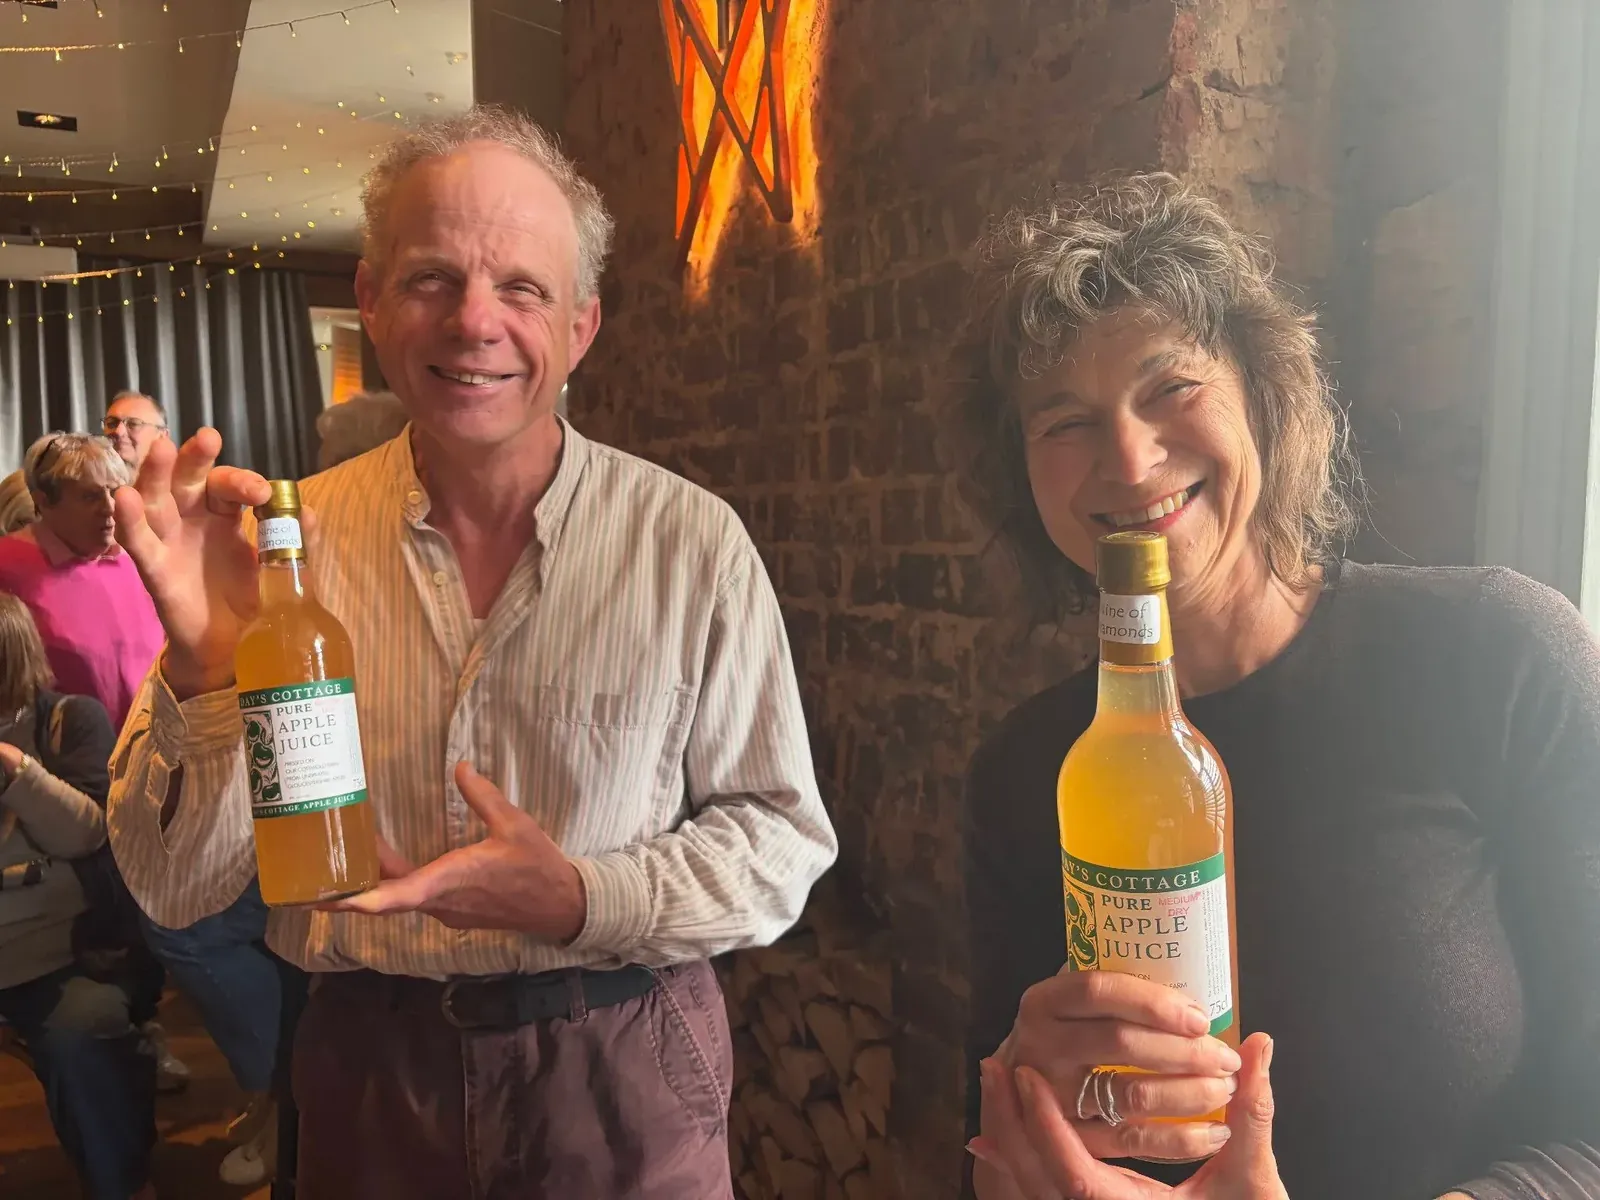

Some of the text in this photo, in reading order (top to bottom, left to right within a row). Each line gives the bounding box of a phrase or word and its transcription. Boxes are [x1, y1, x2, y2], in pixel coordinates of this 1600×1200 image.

[1103, 600, 1149, 618] ine of
[240, 683, 342, 707] DAY'S COTTAGE
[276, 703, 313, 716] PURE
[278, 714, 337, 733] APPLE
[279, 732, 334, 755] JUICE
[264, 804, 300, 814] COTTAGE
[303, 799, 332, 809] APPLE
[333, 794, 355, 804] JUICE
[1062, 858, 1201, 890] AY'S COTTAGE
[1101, 894, 1152, 911] PURE
[1158, 892, 1200, 906] MEDIUM
[1168, 906, 1190, 917] DRY
[1103, 915, 1189, 935] APPLE
[1103, 939, 1182, 960] JUICE
[1209, 995, 1229, 1017] 75cl
